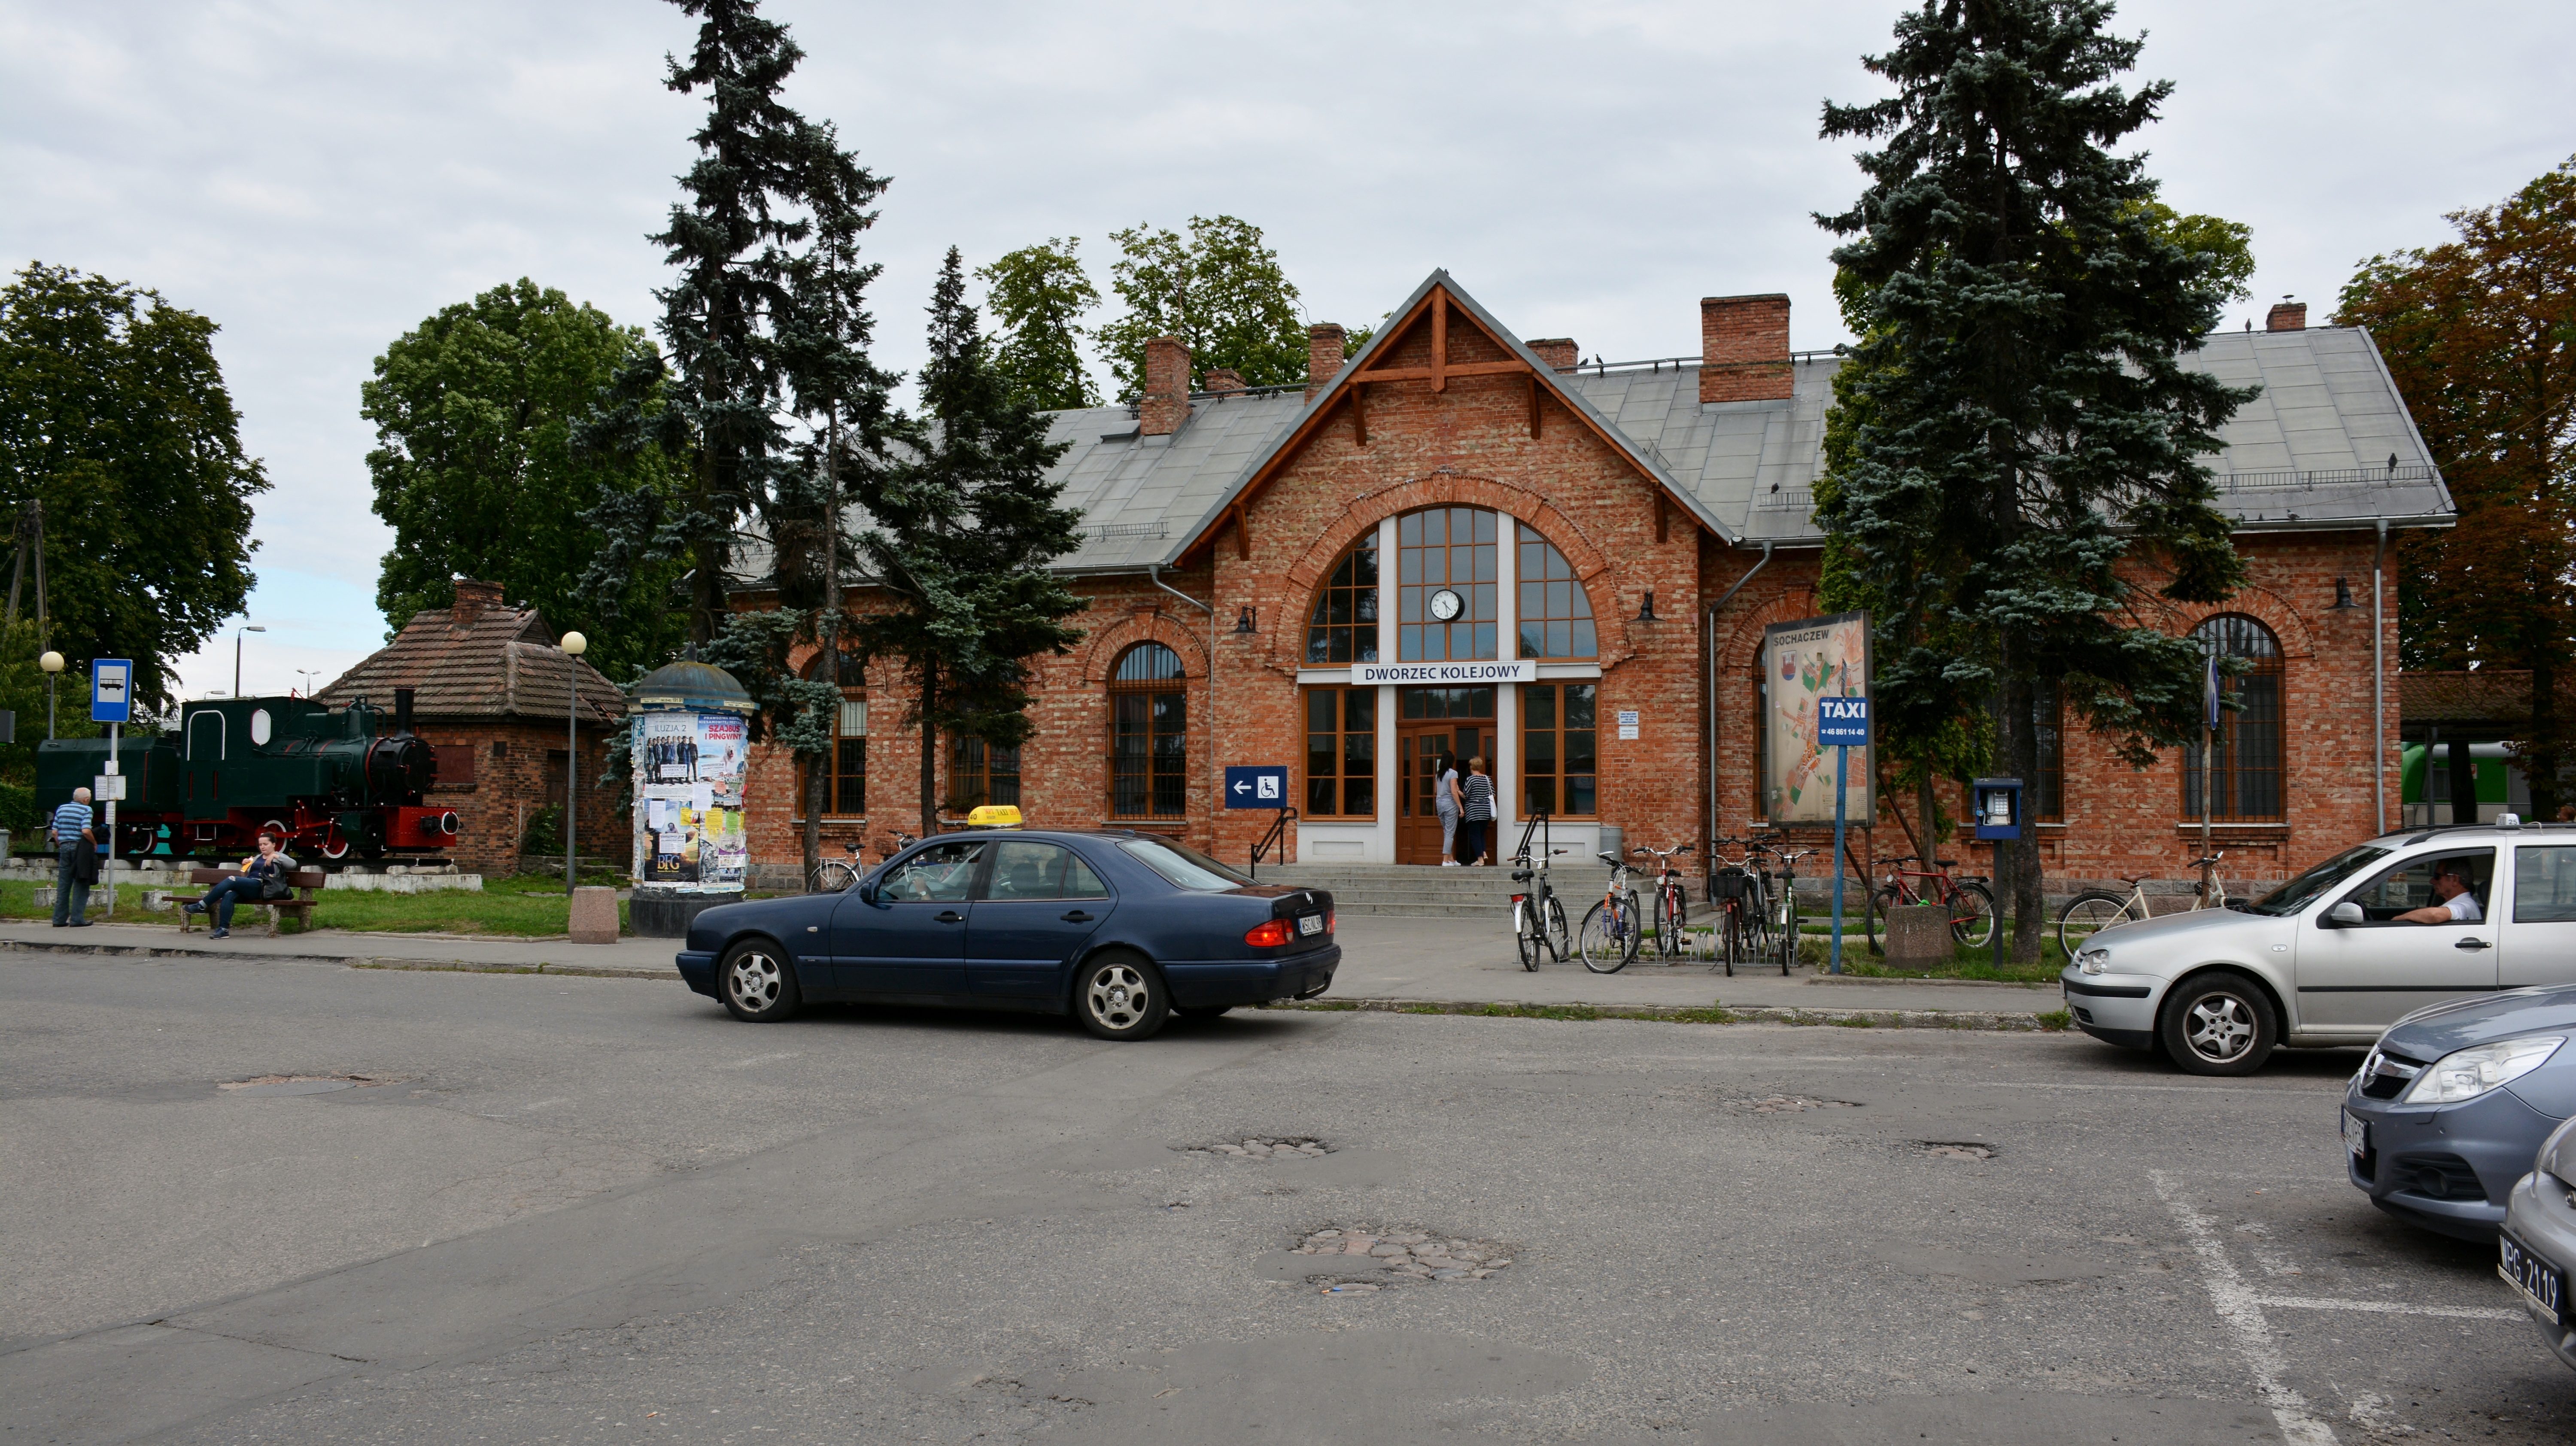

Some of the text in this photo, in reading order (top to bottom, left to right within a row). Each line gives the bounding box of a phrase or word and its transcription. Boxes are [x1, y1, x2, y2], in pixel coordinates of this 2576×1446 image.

[1774, 629, 1829, 647] SOCHACZEW
[1365, 665, 1520, 680] DWORZEC KOLEJOWY
[1821, 702, 1866, 718] TAXI
[708, 724, 741, 732] SZAJBUS
[657, 854, 680, 870] BFG
[2500, 1234, 2521, 1282] WPG
[2527, 1258, 2557, 1309] 2119
